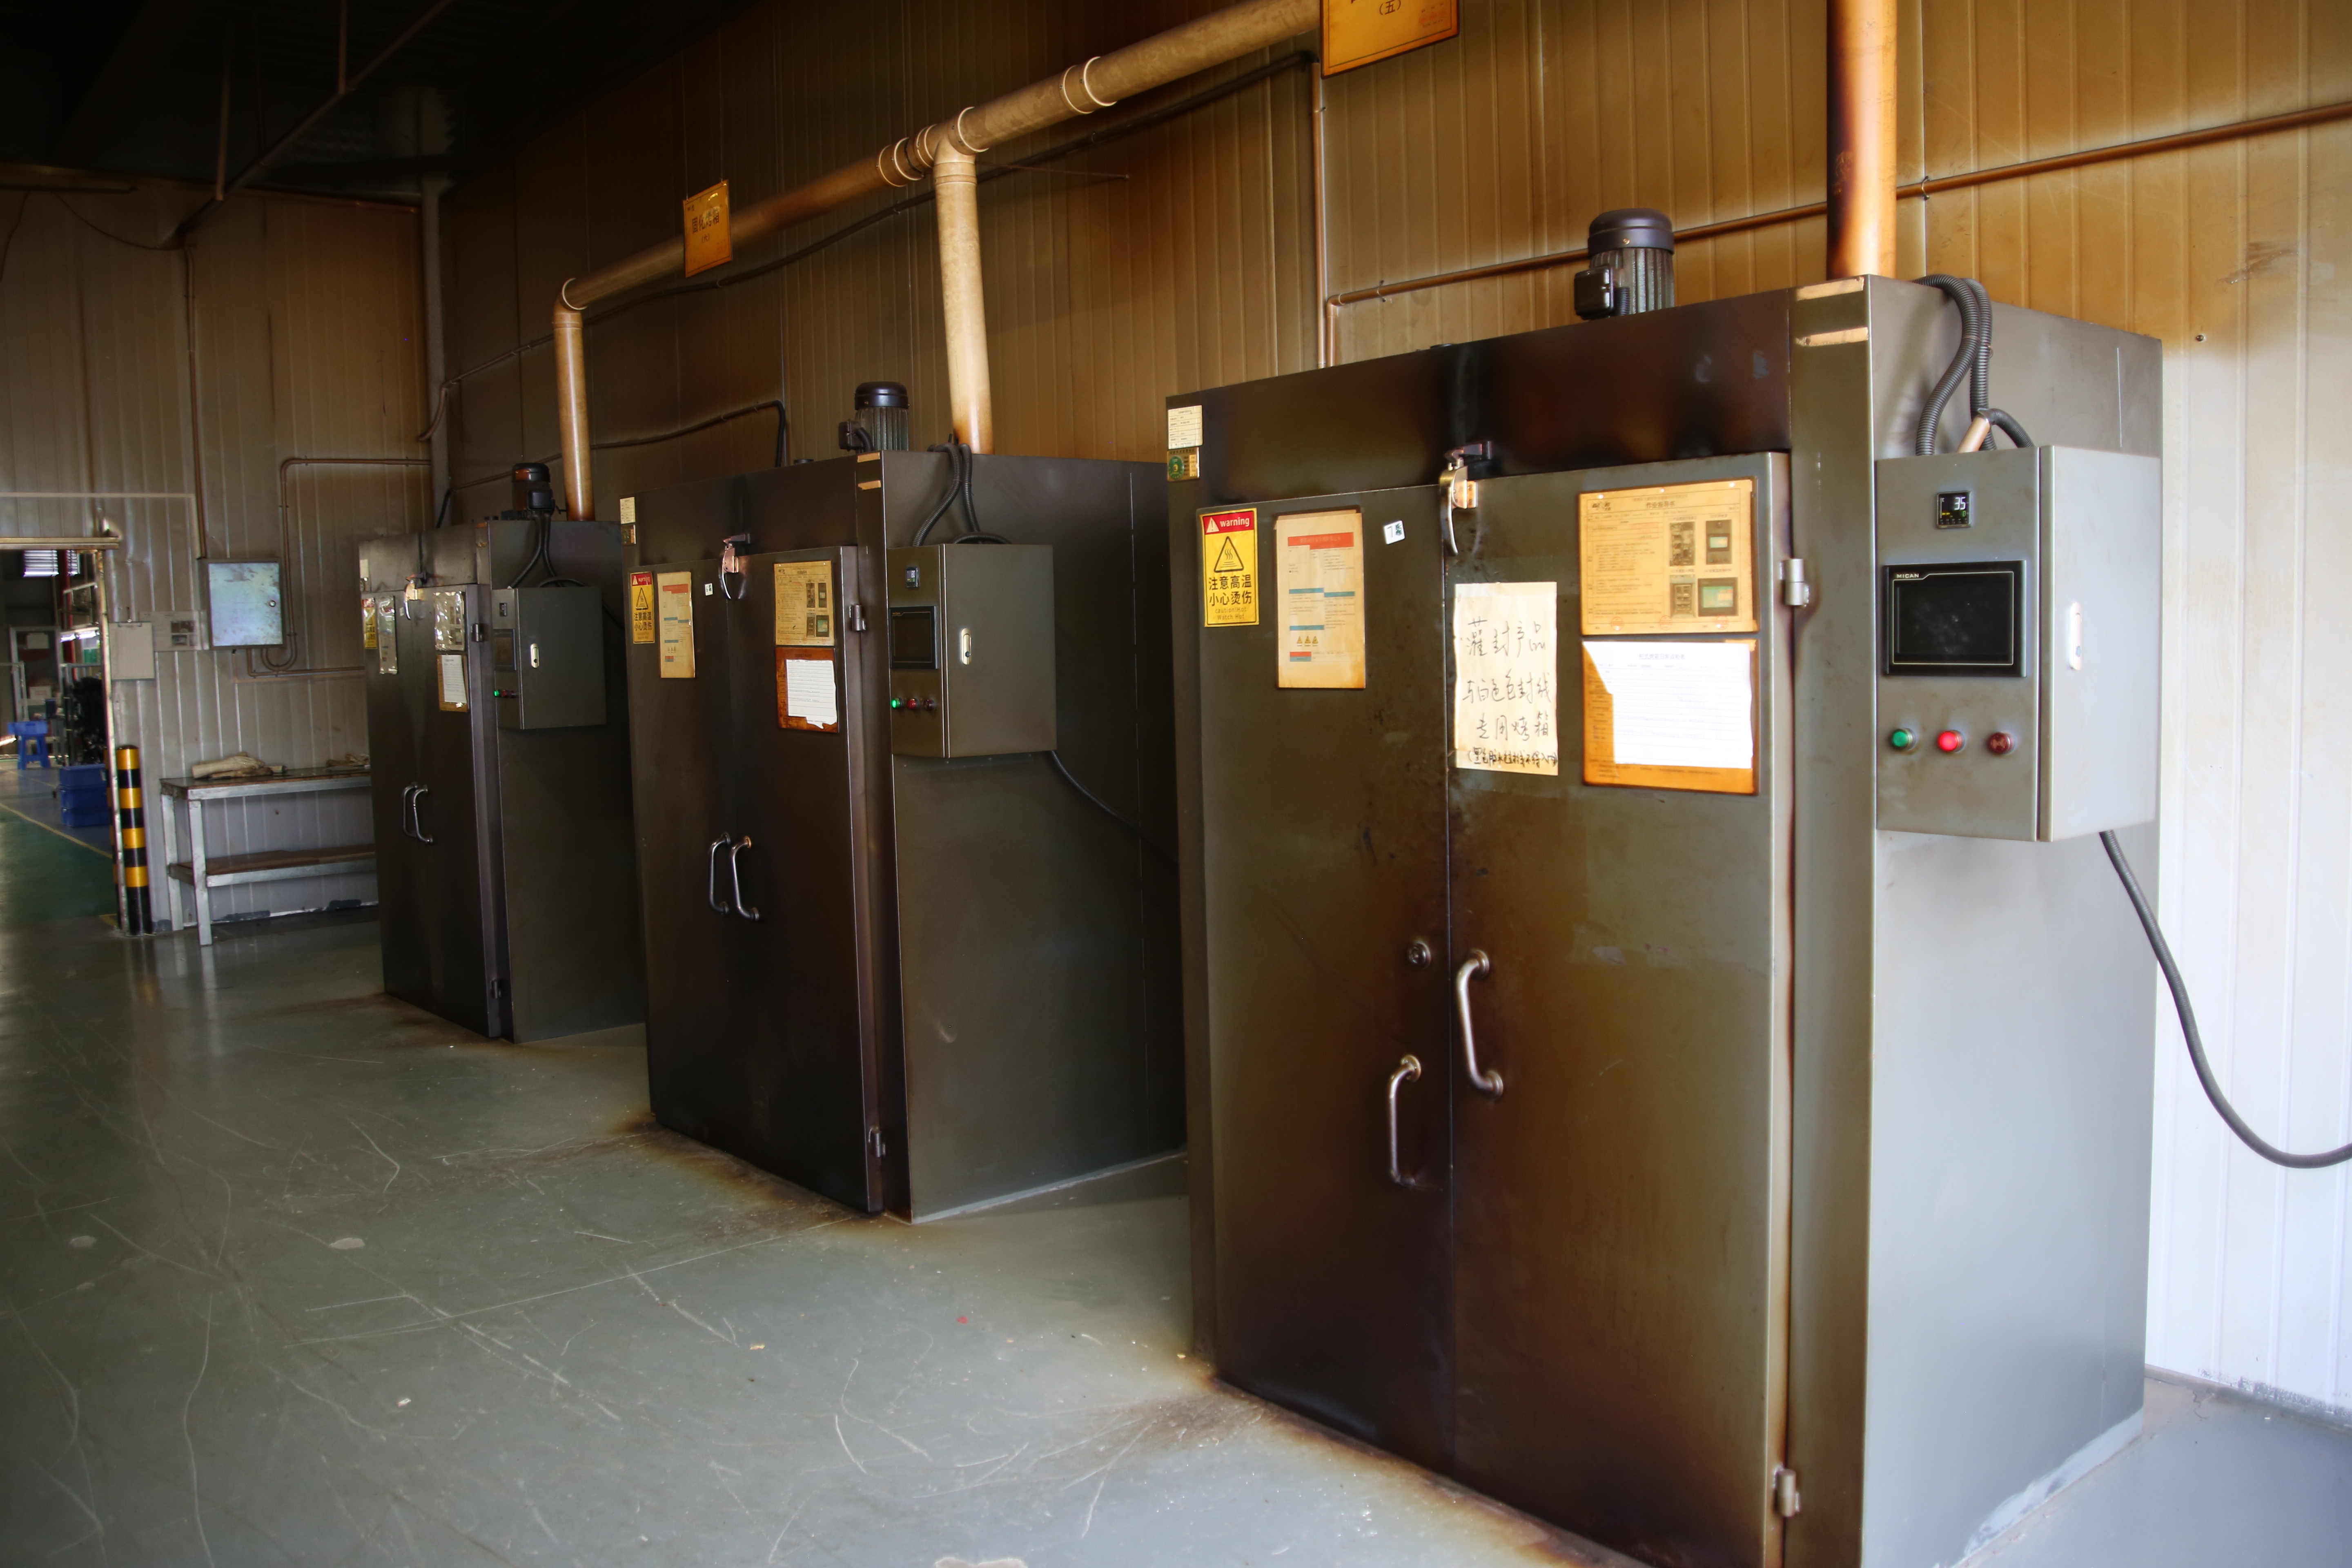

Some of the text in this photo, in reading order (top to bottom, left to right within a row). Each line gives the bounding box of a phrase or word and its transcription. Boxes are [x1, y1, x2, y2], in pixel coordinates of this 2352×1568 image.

[1379, 0, 1401, 15] （五）
[1954, 497, 1966, 510] 35
[1220, 517, 1250, 527] warning
[1209, 574, 1252, 590] 注意高温
[1209, 590, 1252, 606] 小心烫伤
[634, 612, 652, 621] 注意高温
[634, 621, 652, 631] 小心烫伤
[1466, 616, 1546, 658] 灌封产品
[1477, 711, 1549, 741] 专用烤箱
